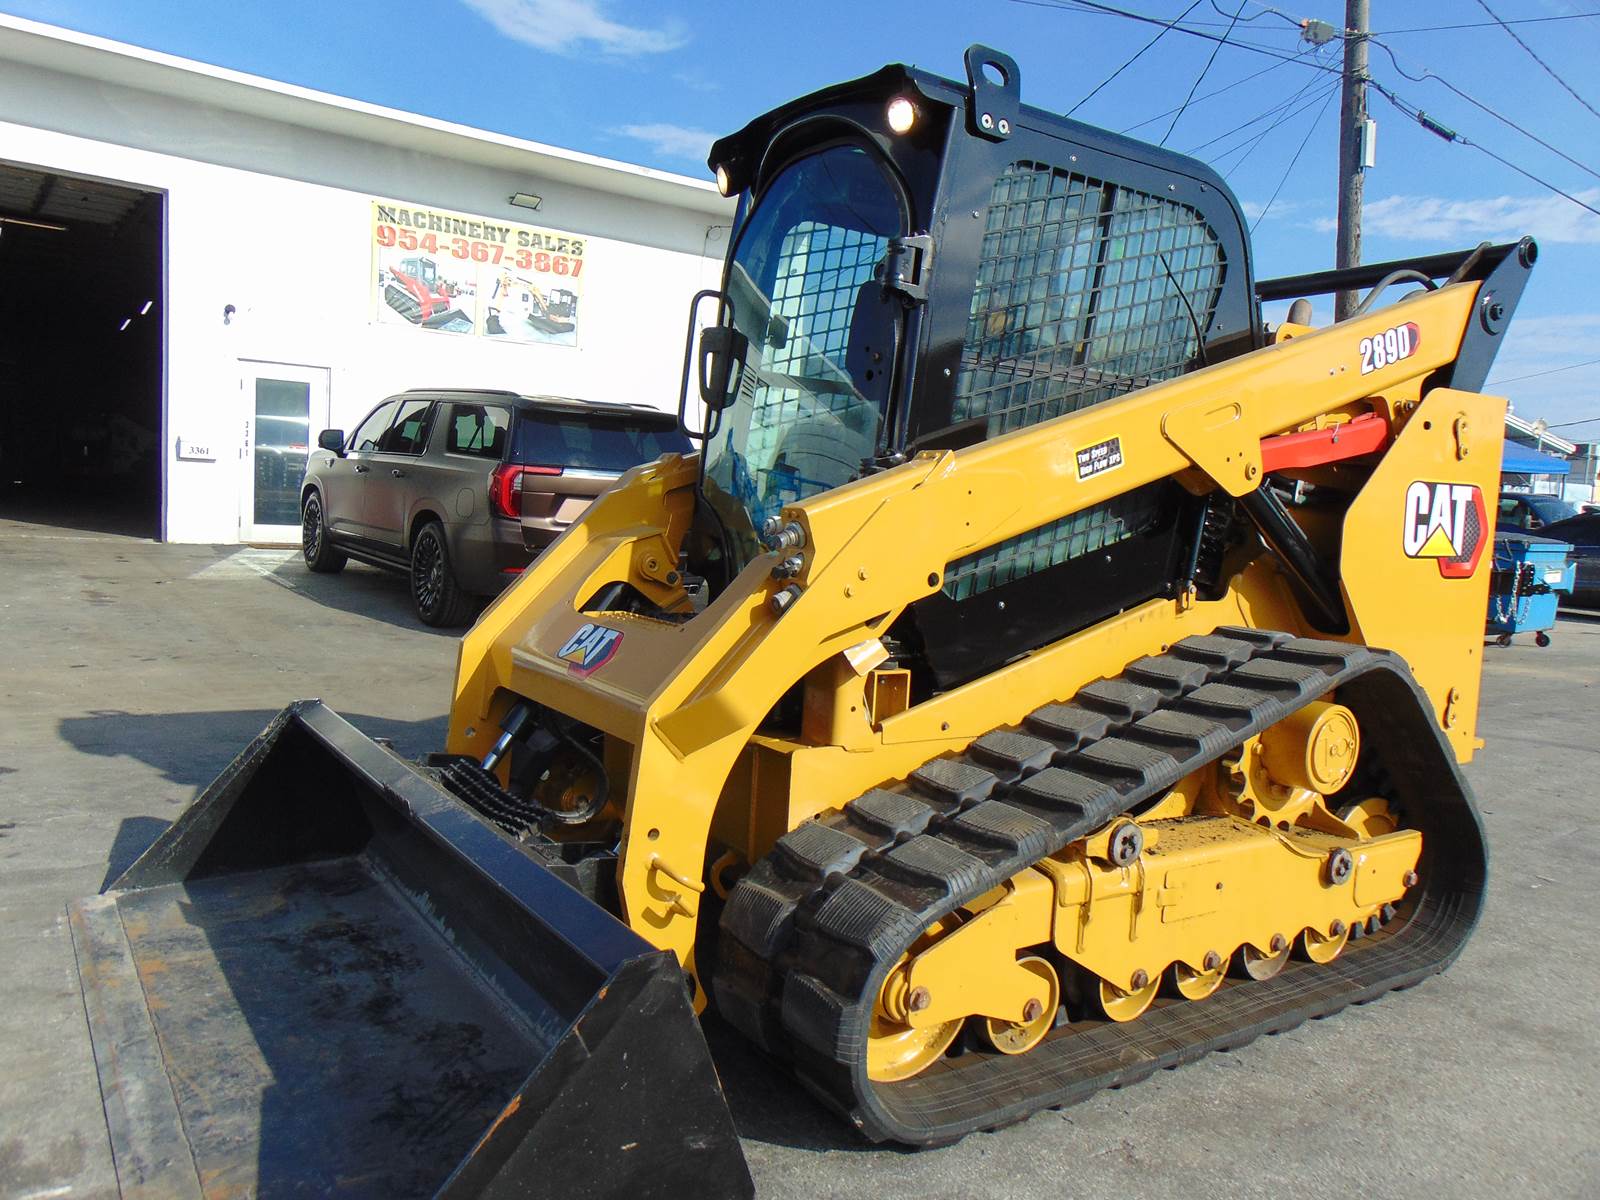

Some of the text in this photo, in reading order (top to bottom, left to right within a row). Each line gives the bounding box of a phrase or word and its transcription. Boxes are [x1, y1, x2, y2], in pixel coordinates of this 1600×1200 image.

[376, 225, 583, 277] 954-367-3867
[377, 205, 583, 256] MACHINERY SALES
[1359, 324, 1410, 375] 289D
[188, 446, 209, 455] 3361
[1403, 481, 1473, 557] CAT
[557, 623, 620, 666] CAT
